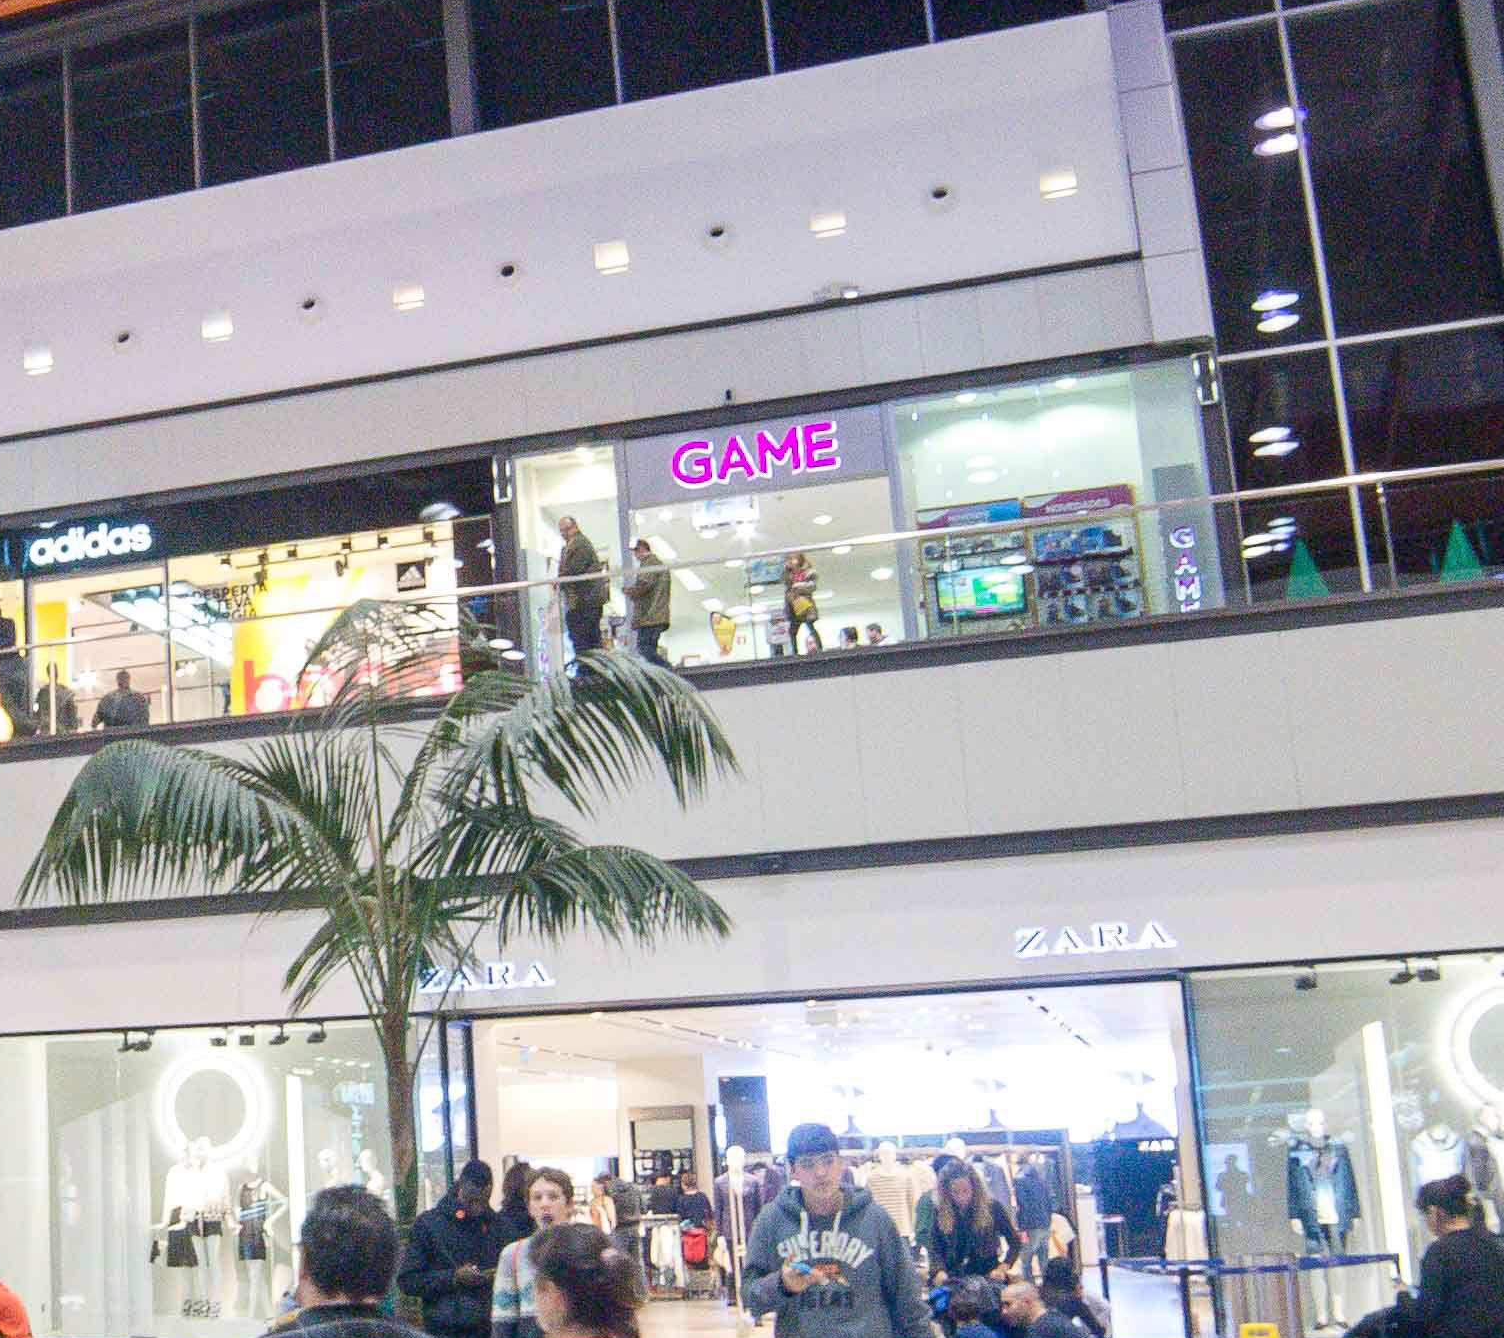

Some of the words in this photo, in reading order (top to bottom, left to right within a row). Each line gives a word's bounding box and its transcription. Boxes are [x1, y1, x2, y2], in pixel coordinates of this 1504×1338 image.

[672, 421, 841, 490] GAME
[29, 523, 153, 567] adidas
[1015, 920, 1178, 959] ZARA
[417, 961, 556, 994] ZARA
